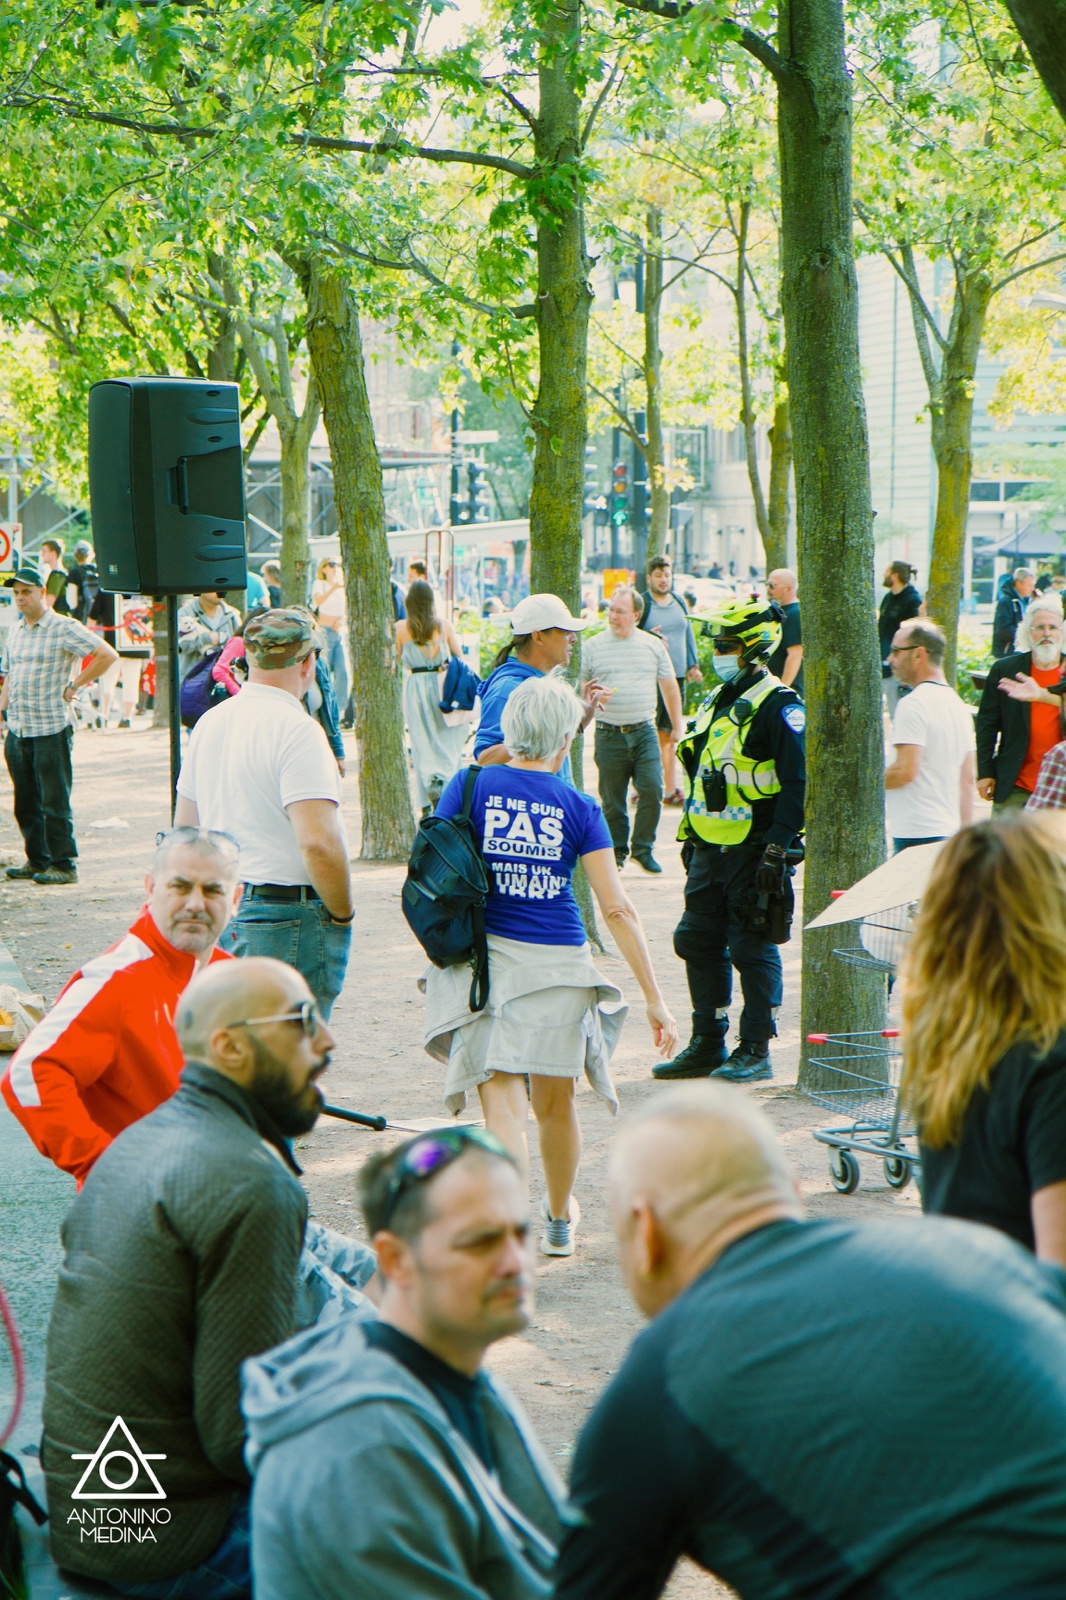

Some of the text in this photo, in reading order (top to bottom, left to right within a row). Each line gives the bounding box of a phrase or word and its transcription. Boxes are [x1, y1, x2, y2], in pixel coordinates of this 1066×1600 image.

[485, 795, 565, 820] JE NE SUIS
[484, 808, 565, 847] PAS
[487, 839, 558, 857] SOUMIS
[491, 862, 528, 874] MAIS
